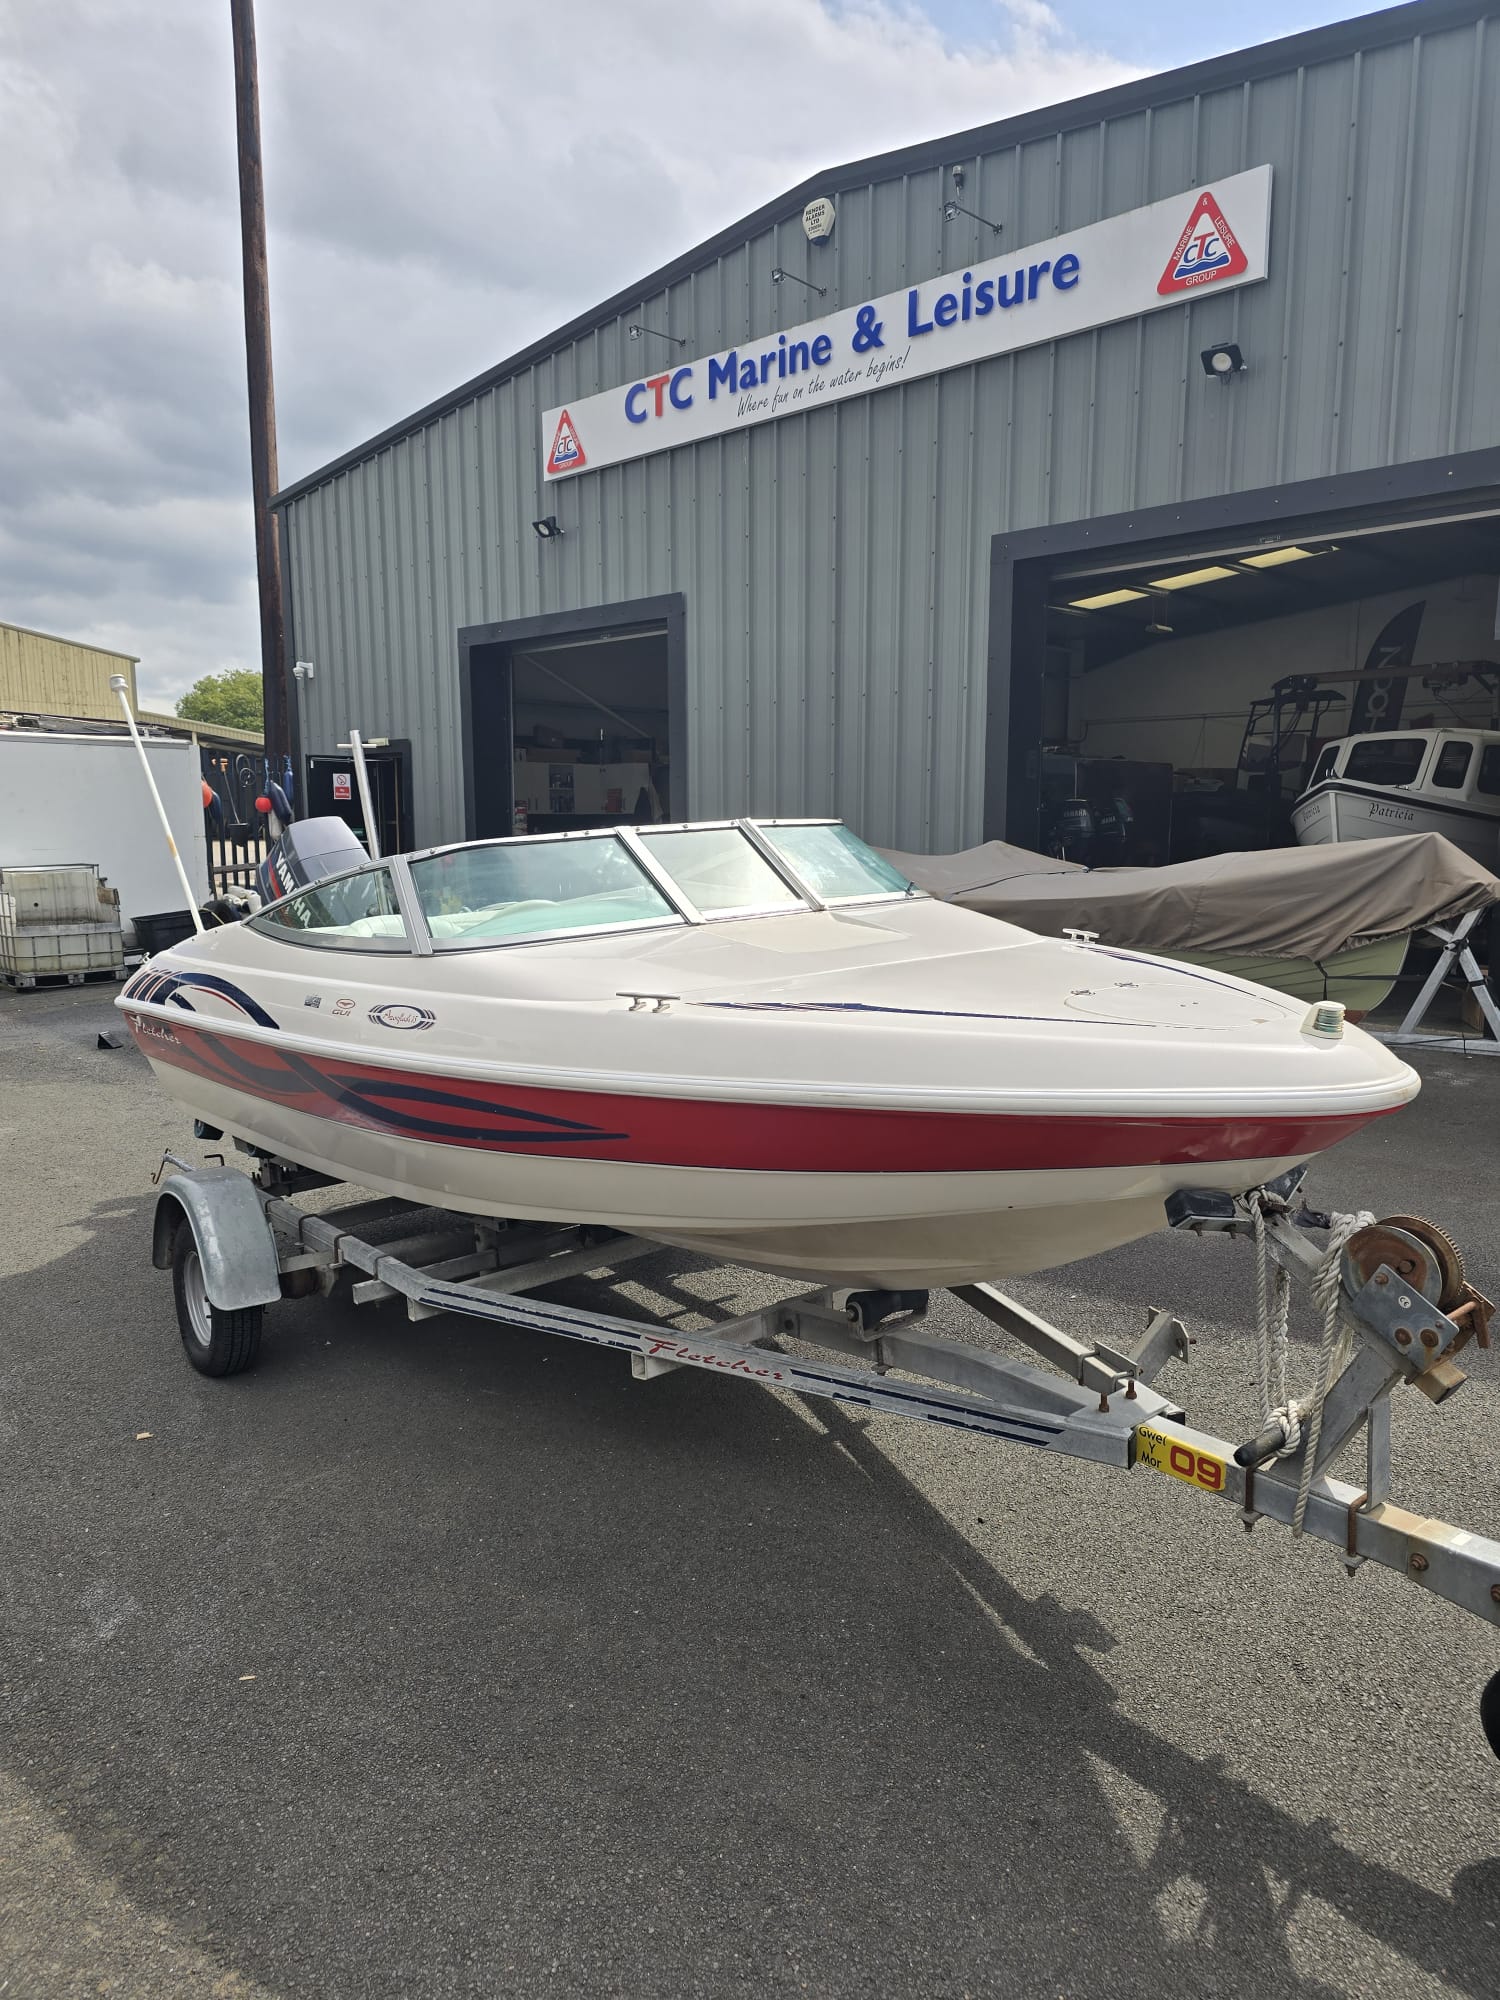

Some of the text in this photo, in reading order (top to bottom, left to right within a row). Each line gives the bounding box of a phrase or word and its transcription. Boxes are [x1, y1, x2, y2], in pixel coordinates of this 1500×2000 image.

[1202, 197, 1208, 206] &
[810, 218, 820, 226] LTD
[1214, 216, 1235, 248] LEISURE
[1172, 225, 1194, 261] MARINE
[1183, 231, 1220, 264] CTC
[1185, 270, 1217, 286] GROUP
[624, 253, 1080, 423] CTC Marine & Leisure
[737, 345, 911, 417] Where fun on the water begins!
[557, 435, 573, 454] CTC
[1368, 802, 1415, 821] Patricia
[129, 1015, 182, 1044] Fletcher
[644, 1336, 784, 1380] Fletcher
[1138, 1426, 1167, 1446] Gwel
[1148, 1442, 1156, 1454] Y
[1141, 1451, 1162, 1468] Mor
[1170, 1445, 1221, 1489] 09
